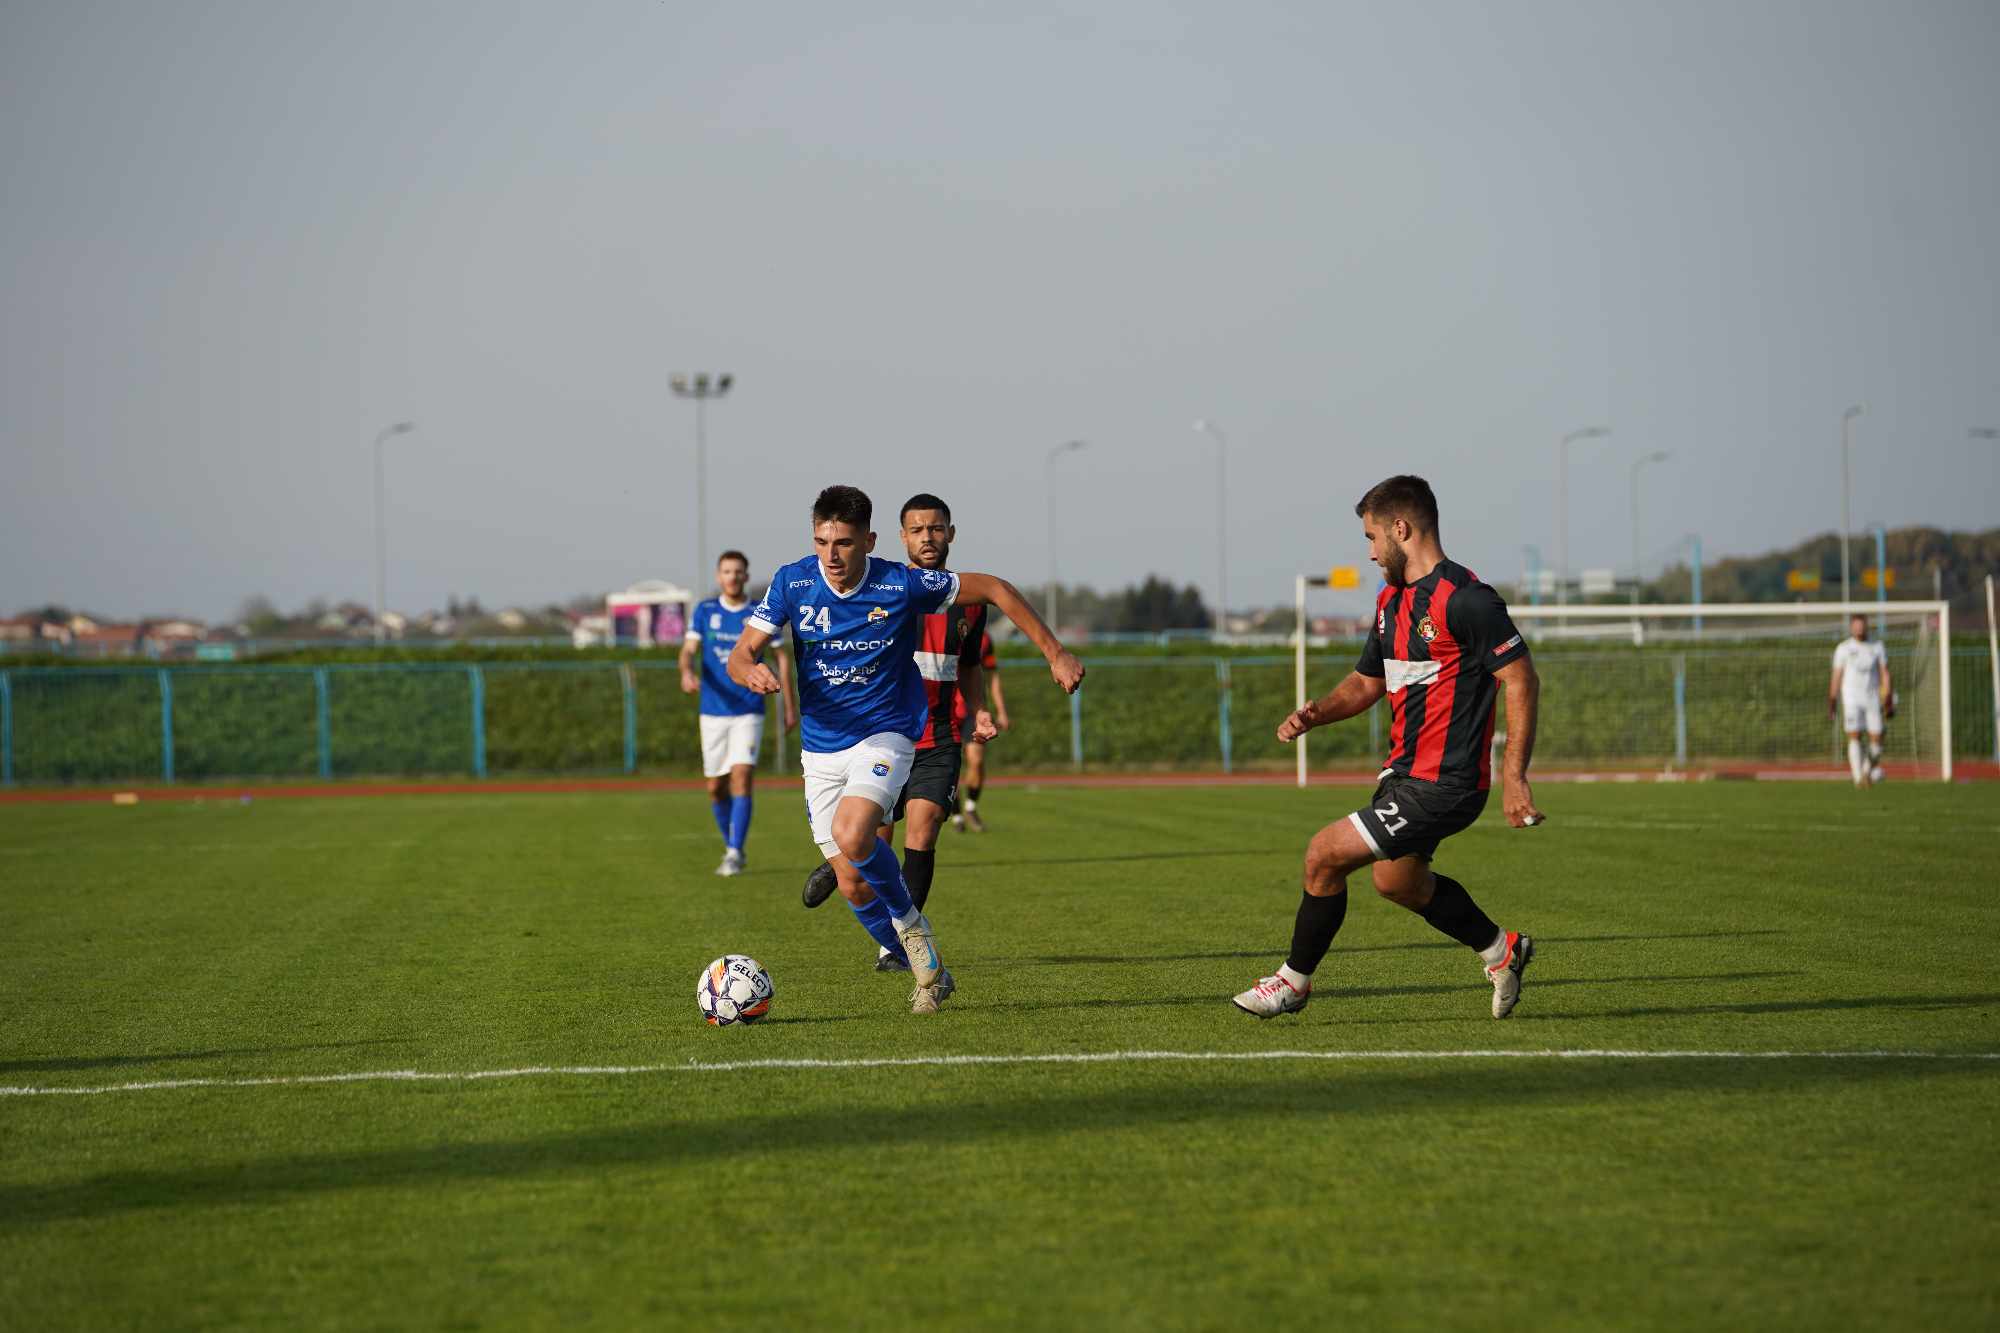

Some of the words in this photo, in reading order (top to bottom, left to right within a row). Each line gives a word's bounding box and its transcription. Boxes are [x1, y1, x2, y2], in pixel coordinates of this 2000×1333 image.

[799, 604, 831, 634] 24
[1374, 801, 1409, 837] 21
[733, 963, 768, 993] SELECT
